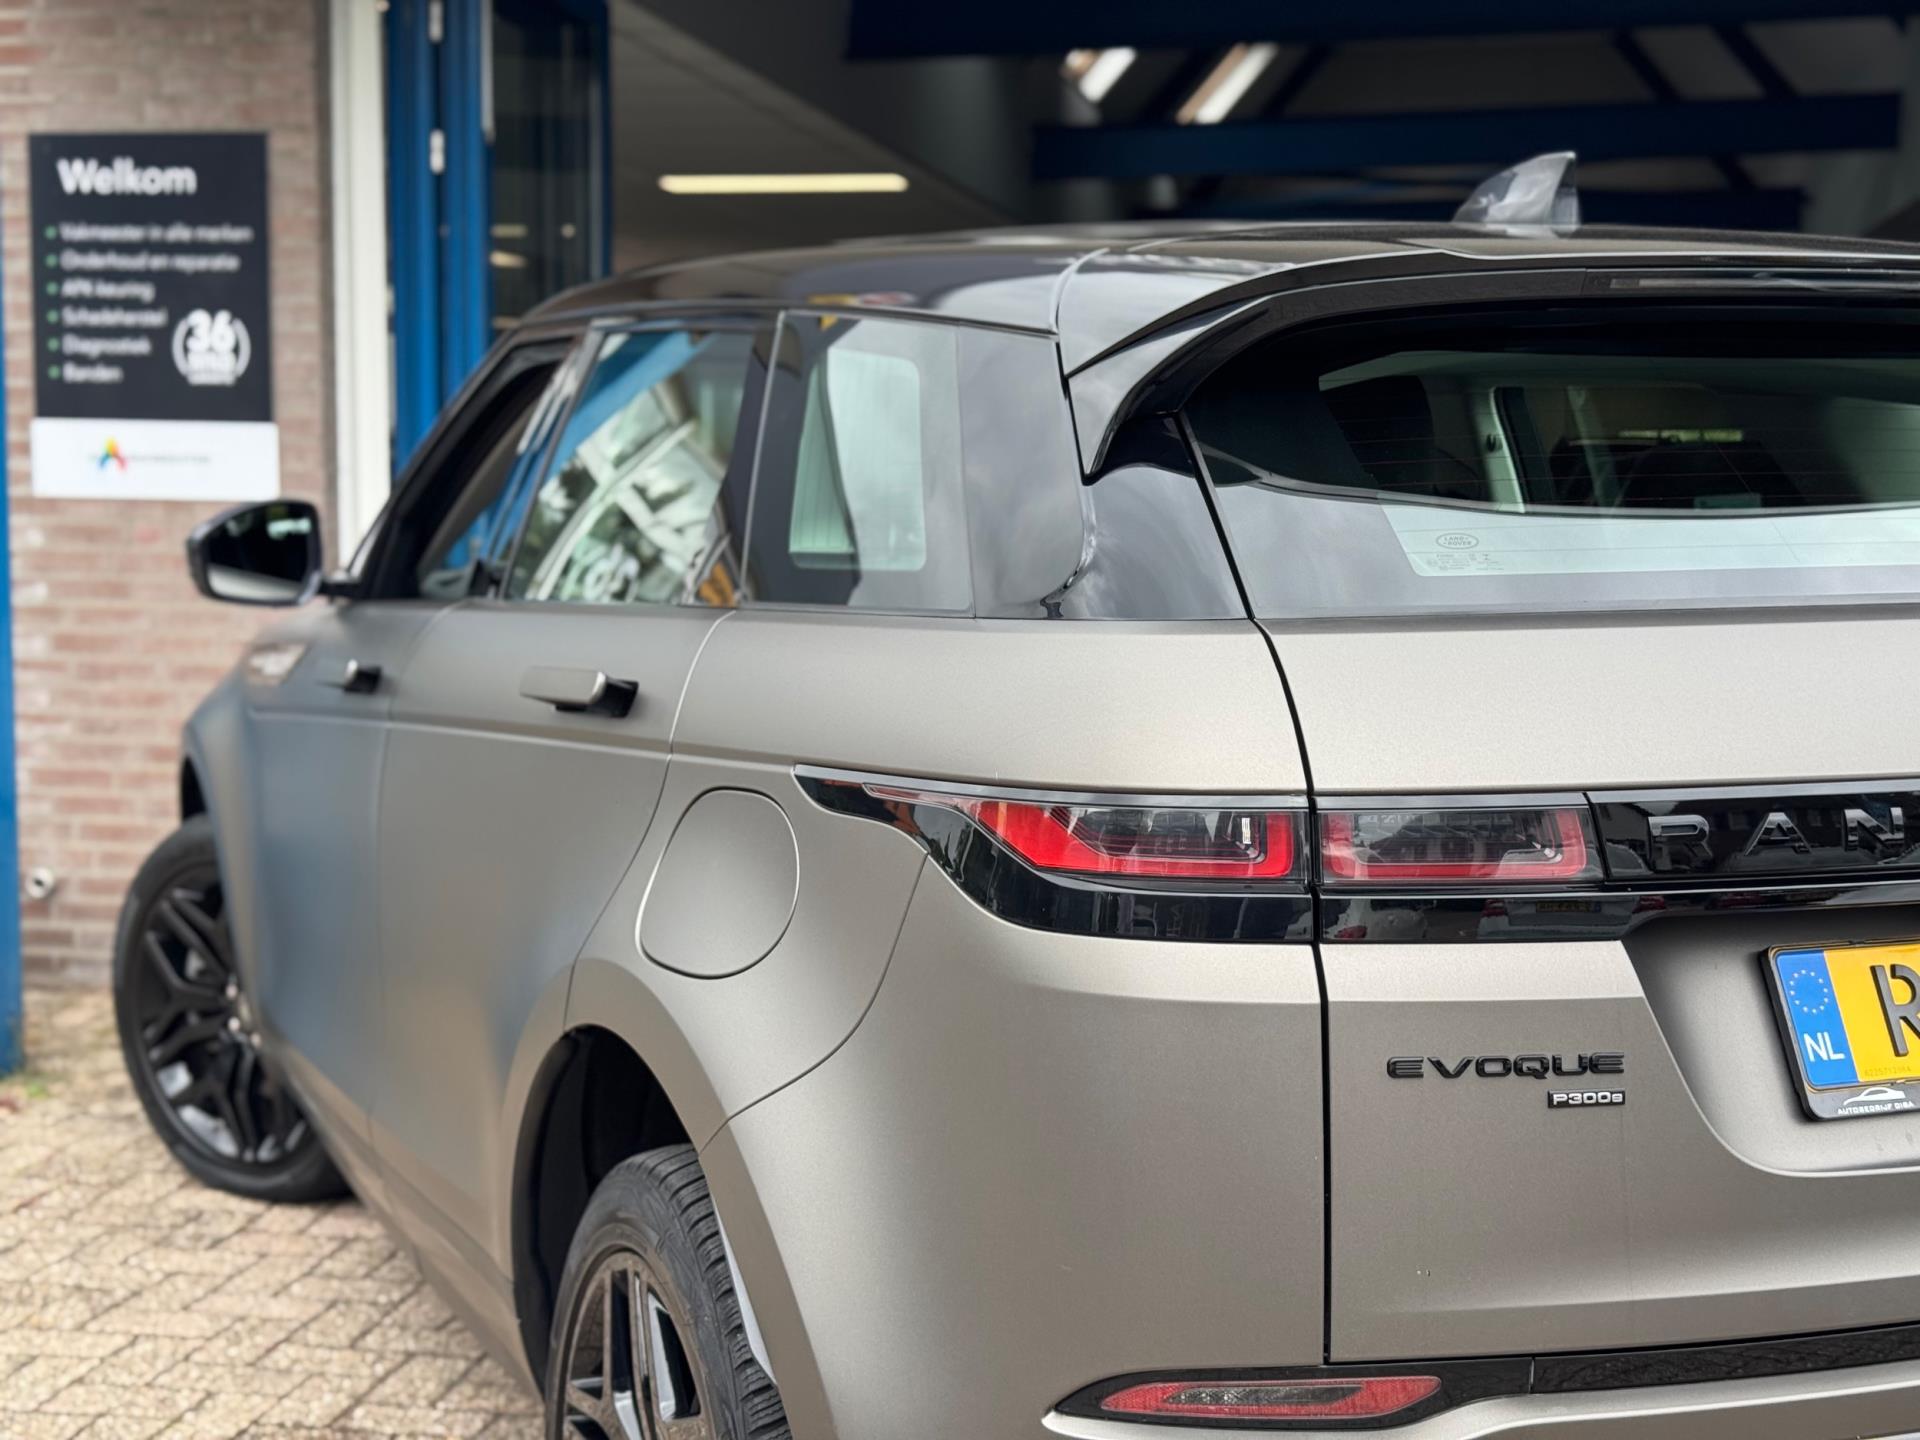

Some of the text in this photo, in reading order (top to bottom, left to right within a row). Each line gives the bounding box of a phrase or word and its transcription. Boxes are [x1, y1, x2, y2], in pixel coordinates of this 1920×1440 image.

[56, 157, 197, 194] Welkom
[186, 309, 236, 350] 36
[1803, 1031, 1846, 1062] NL
[1387, 1052, 1625, 1079] EVOQUE
